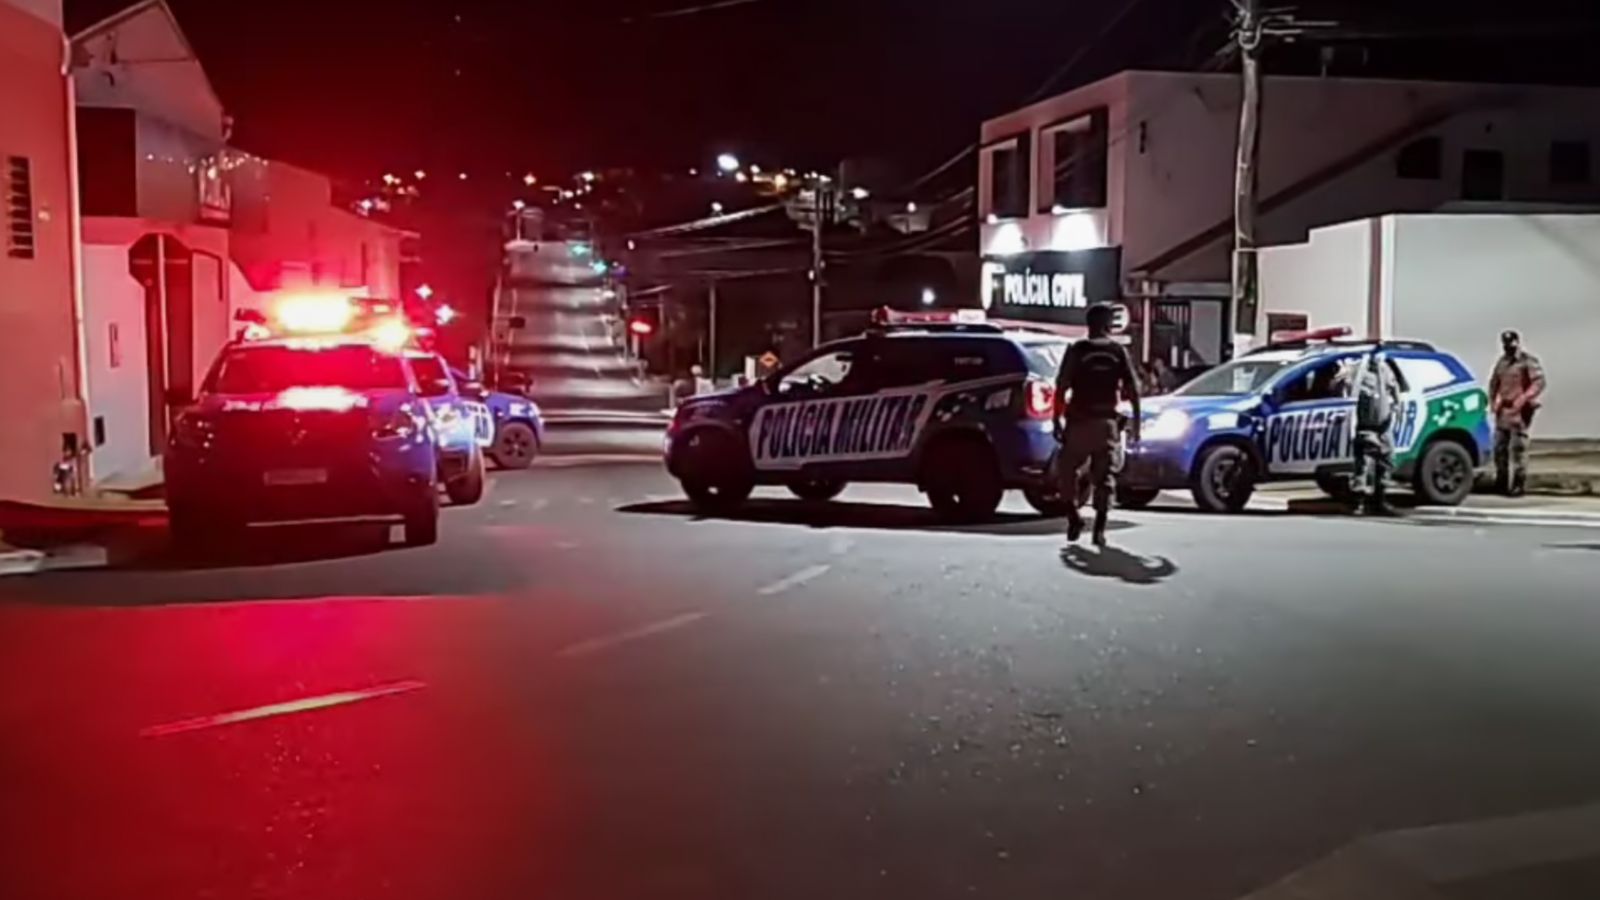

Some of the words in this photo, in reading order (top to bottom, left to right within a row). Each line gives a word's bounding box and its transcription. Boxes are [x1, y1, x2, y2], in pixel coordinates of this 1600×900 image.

[1004, 267, 1050, 306] POLÍCIA
[1051, 273, 1088, 308] CIVIL
[832, 394, 928, 453] MILITAR
